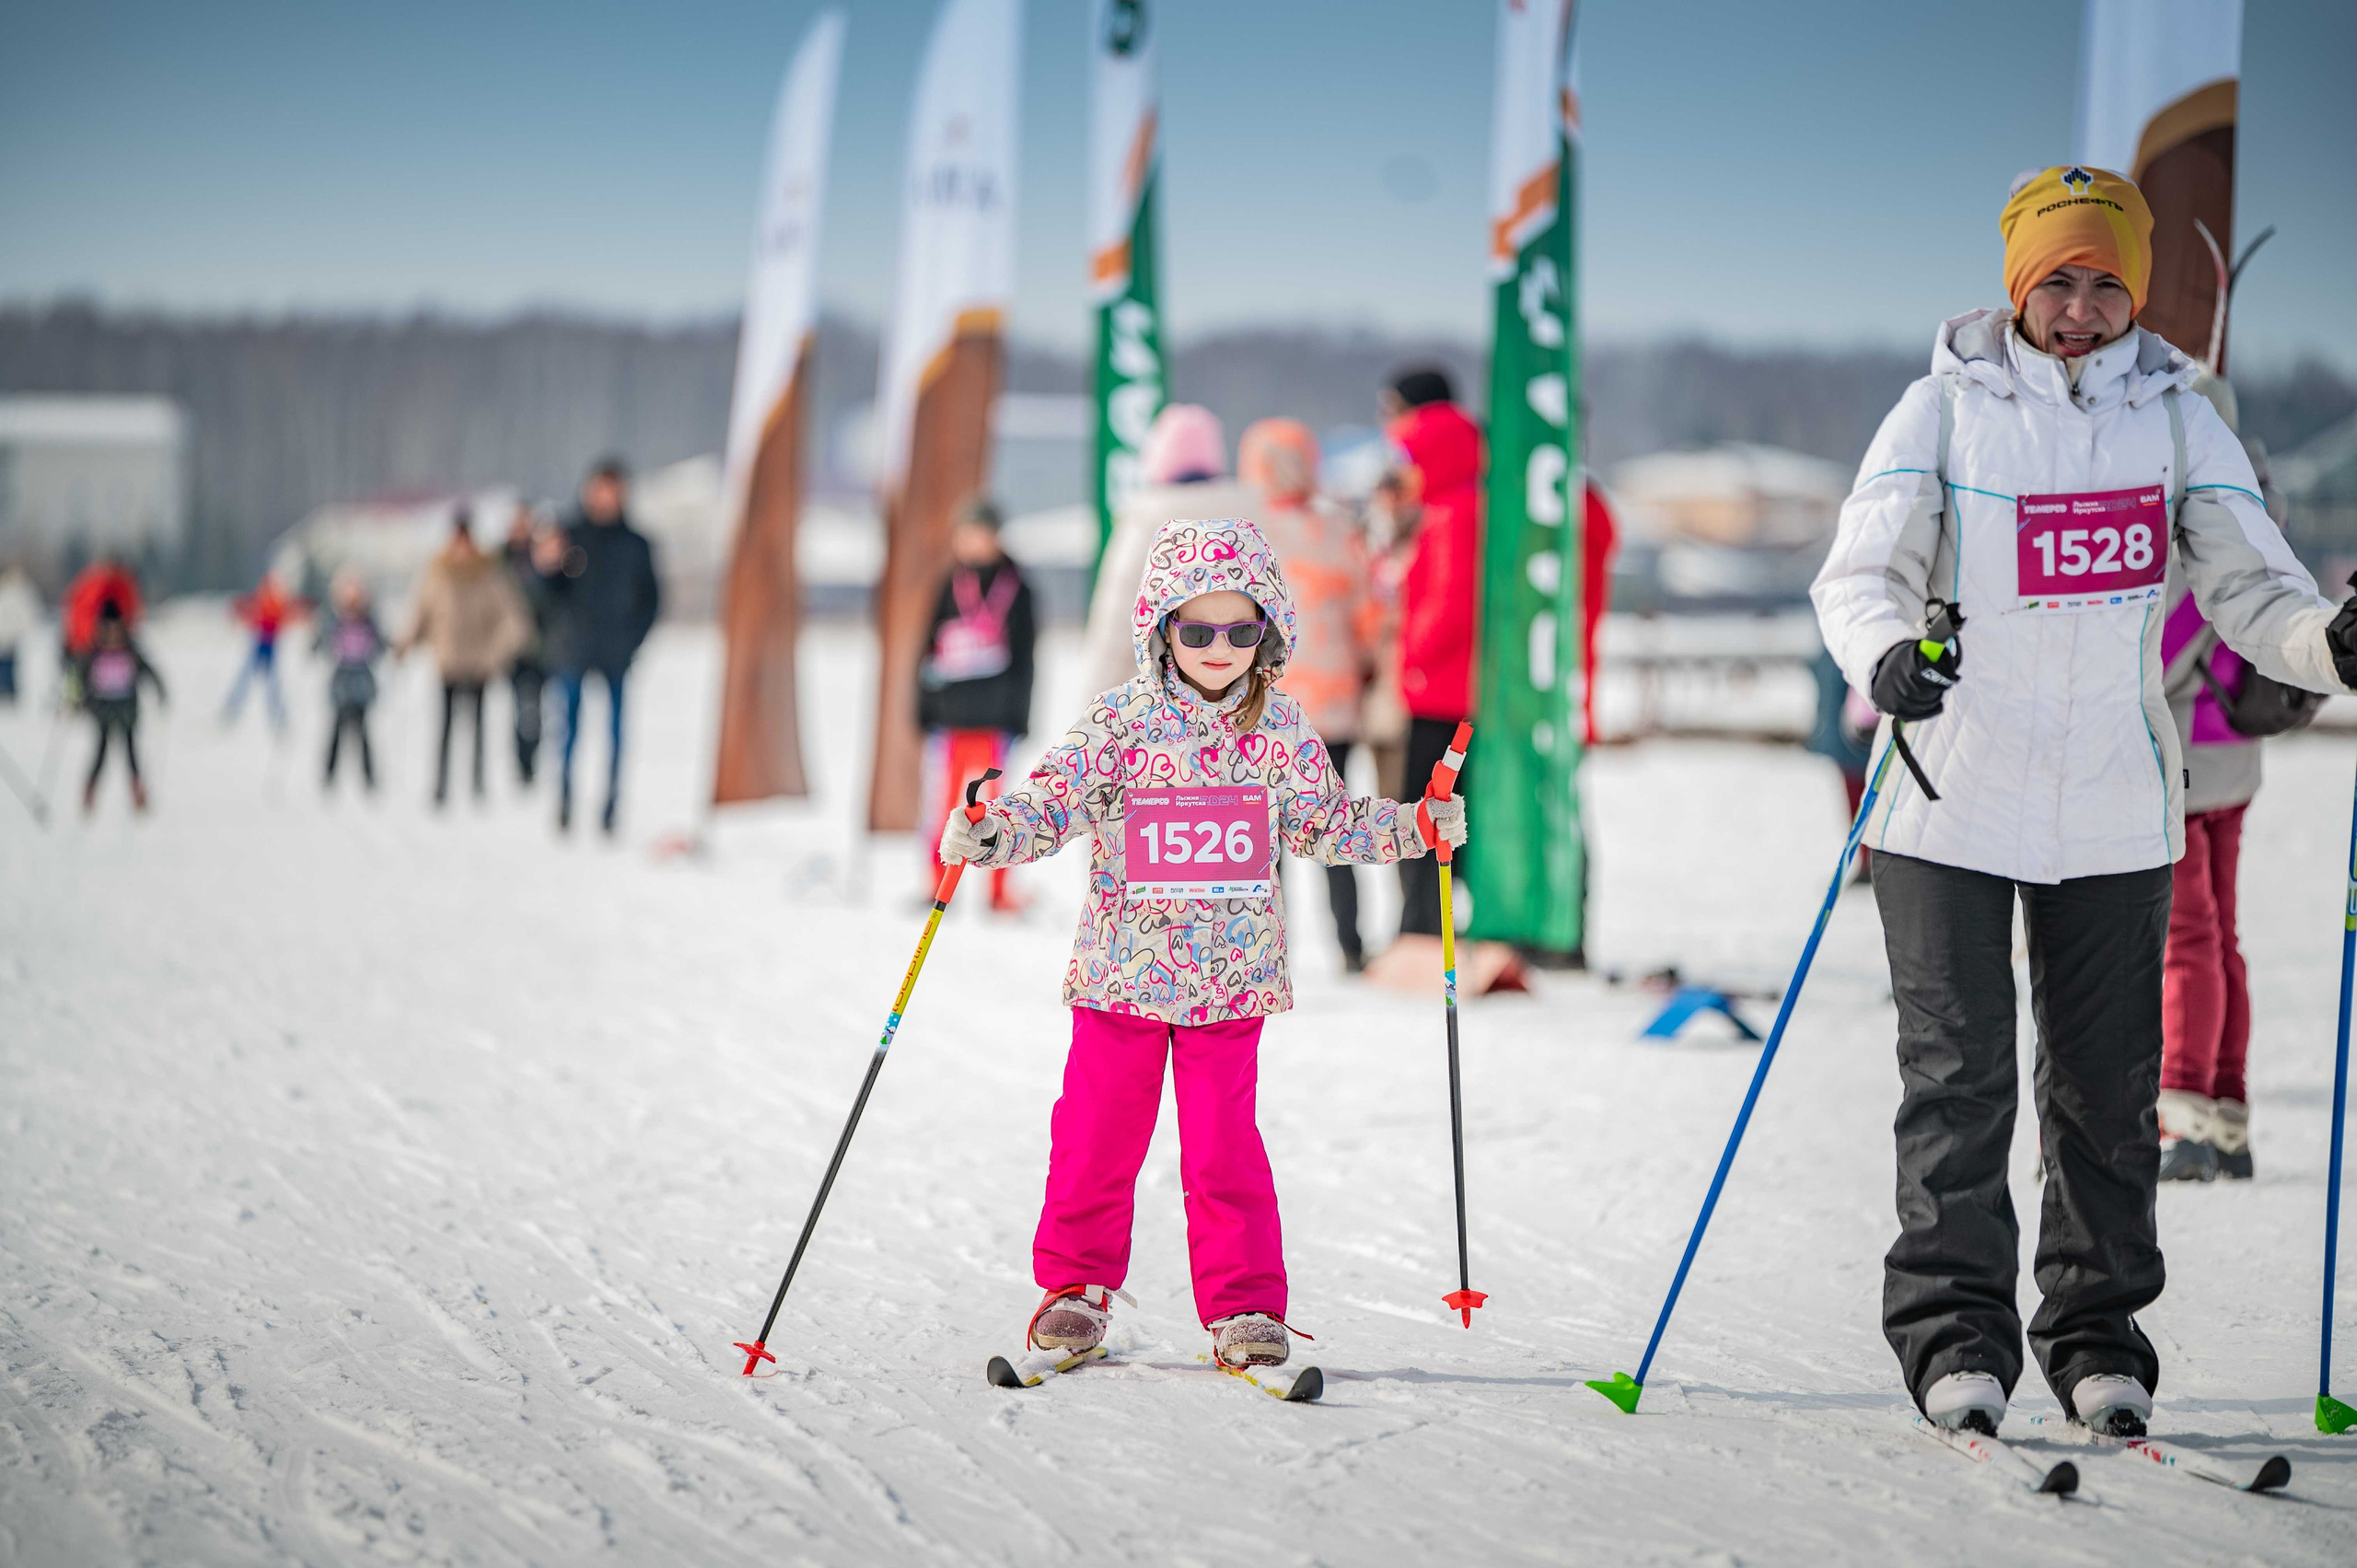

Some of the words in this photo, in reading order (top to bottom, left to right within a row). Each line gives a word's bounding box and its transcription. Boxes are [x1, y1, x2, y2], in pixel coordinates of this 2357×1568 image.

[2037, 197, 2124, 217] РОСНЕФТЬ
[2140, 494, 2160, 504] БАМ
[2032, 523, 2154, 577] 1528
[1131, 797, 1171, 806] ТЕМЕРСО
[1139, 819, 1254, 865] 1526
